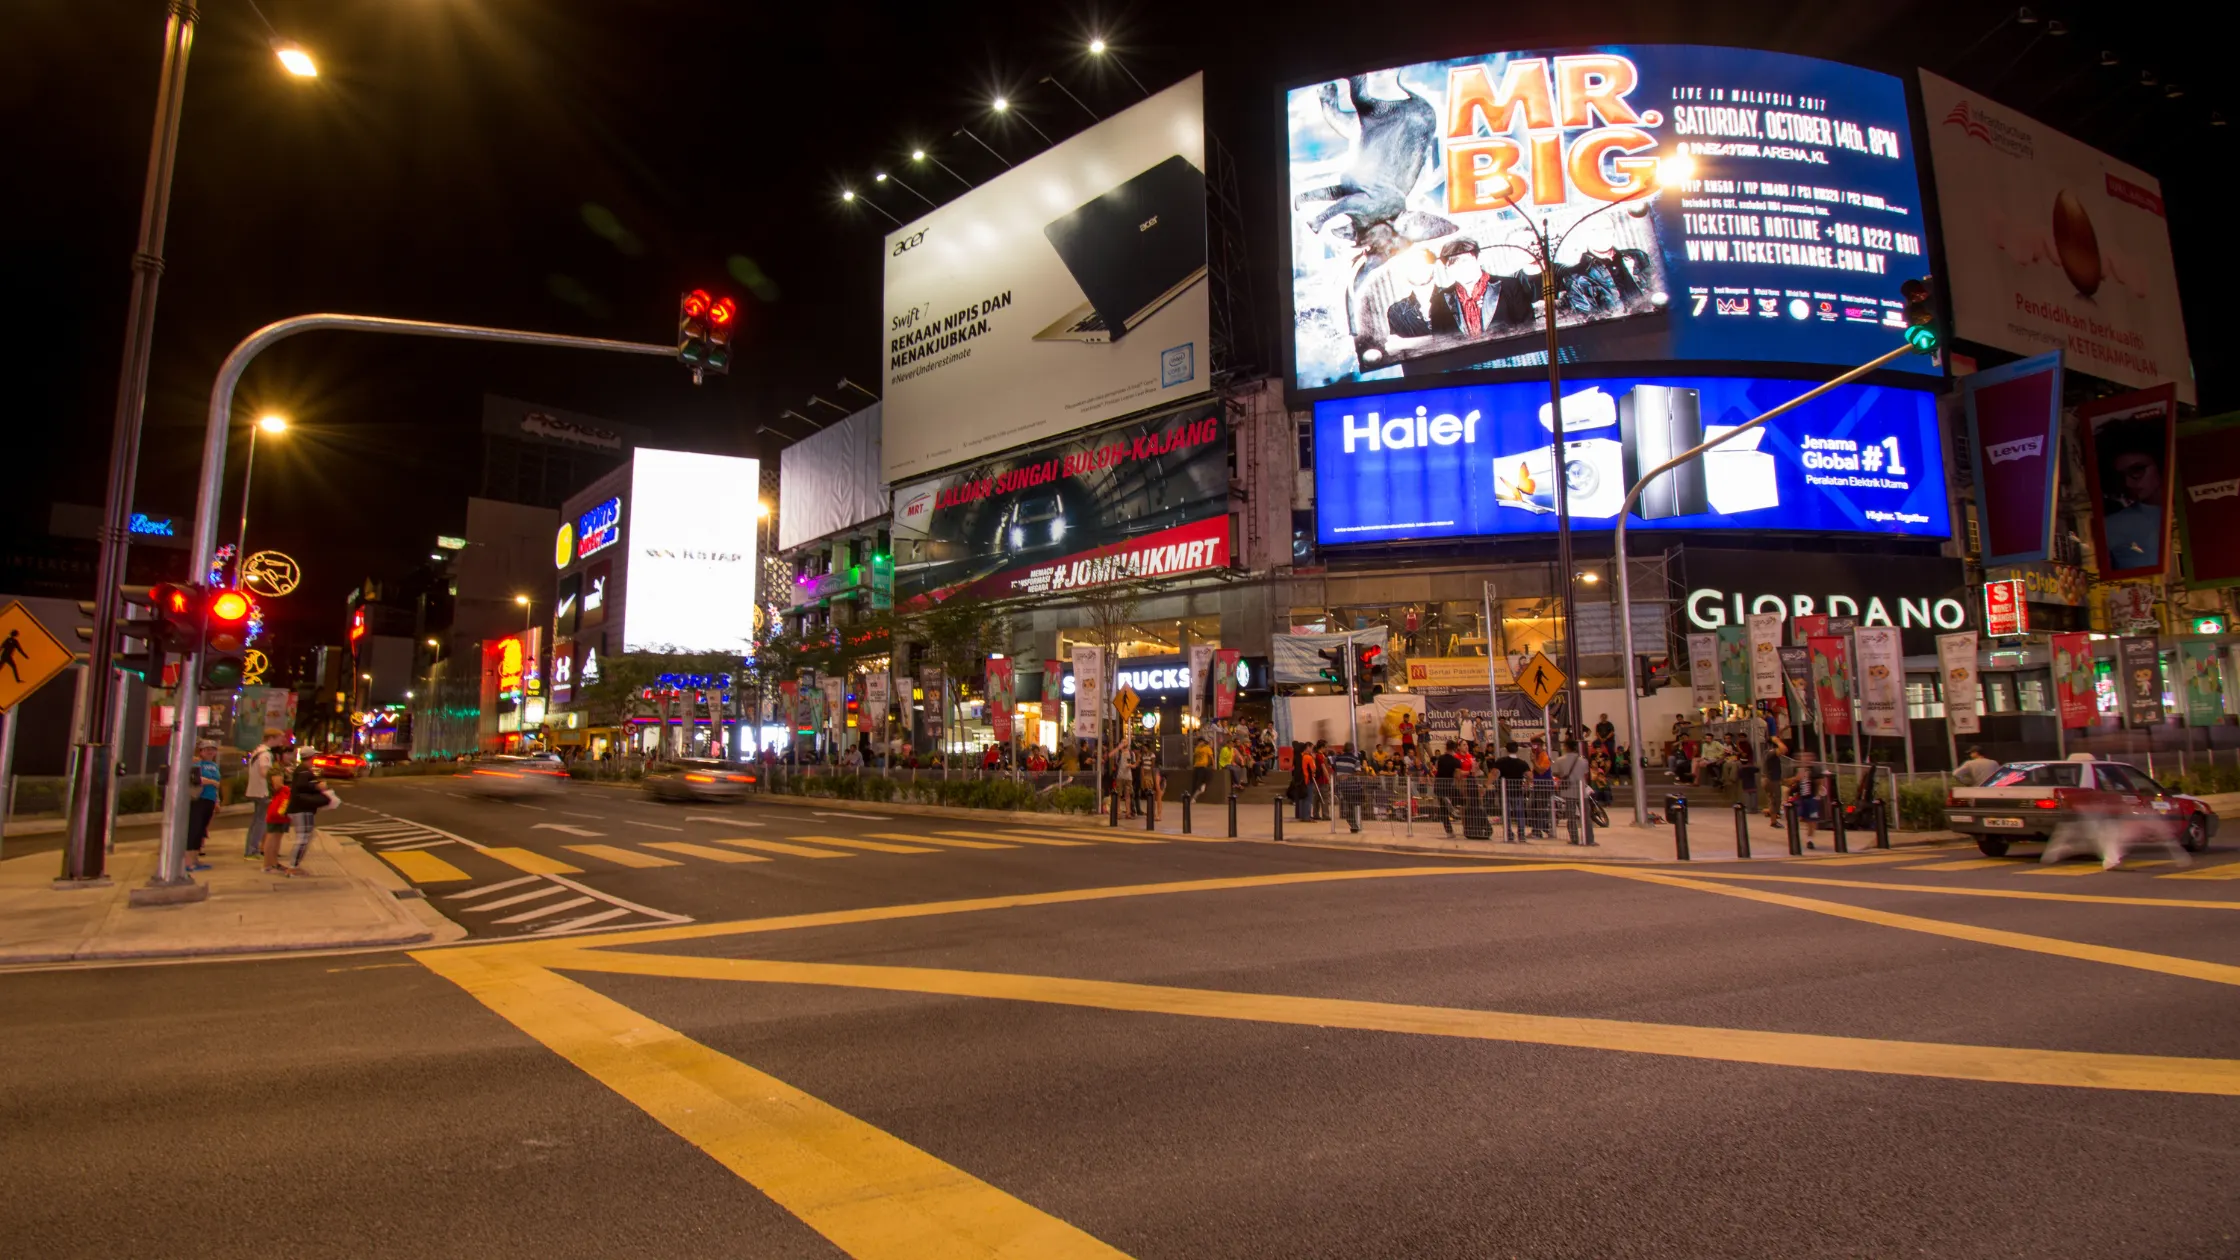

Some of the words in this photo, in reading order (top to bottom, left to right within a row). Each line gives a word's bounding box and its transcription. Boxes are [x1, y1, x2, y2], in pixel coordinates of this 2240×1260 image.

[1447, 53, 1664, 138] MR.
[1672, 87, 1702, 100] LIVE
[1710, 88, 1724, 101] IN
[1731, 89, 1793, 107] MALAYSIA
[1799, 96, 1826, 111] 2017
[1673, 105, 1763, 140] SATURDAY,
[1765, 110, 1832, 147] OCTOBER
[1833, 120, 1868, 154] 14th,
[1868, 126, 1900, 159] 8PM
[1990, 131, 2034, 160] University
[1447, 126, 1663, 214] BIG
[1743, 182, 1758, 194] VIP
[1139, 215, 1159, 233] acer
[1683, 213, 1760, 237] TICKETING
[1764, 216, 1821, 242] HOTLINE
[1825, 222, 1860, 247] +603
[892, 226, 930, 257] acer
[1685, 240, 1886, 275] WWW.TICKETCHARGE.COM.MY
[891, 320, 941, 354] REKAAN
[944, 304, 978, 331] NIPIS
[982, 290, 1011, 316] DAN
[892, 307, 920, 331] Swift
[923, 302, 930, 317] 7
[2015, 292, 2087, 333] Pendidikan
[2089, 317, 2145, 349] berkualiti
[890, 319, 992, 371] MENAKJUBKAN.
[2067, 334, 2158, 377] KETERAMPILAN
[891, 347, 972, 386] #NeverUnderestimate
[1343, 405, 1481, 454] Haier
[1801, 434, 1858, 451] Jenama
[935, 475, 992, 511] LALUAN
[995, 460, 1058, 496] SUNGAI
[1062, 417, 1218, 478] BULOH-KAJANG
[1802, 451, 1860, 471] Global
[1861, 436, 1906, 475] #1
[1806, 474, 1848, 486] Peralatan
[1849, 476, 1880, 488] Elektrik
[1880, 478, 1909, 490] Utama
[578, 497, 621, 538] SPORTS
[907, 504, 924, 517] MRT
[1895, 512, 1929, 523] Together
[578, 527, 620, 559] DIRECT
[1030, 567, 1055, 578] MEMACU
[1052, 537, 1220, 589] #JOMNAIKMRT
[1011, 575, 1051, 588] TNSFORMASI
[2026, 571, 2059, 594] Club
[1686, 588, 1966, 630] GIORDANO
[1062, 667, 1191, 695] SBUCKS
[1467, 708, 1521, 719] emetara
